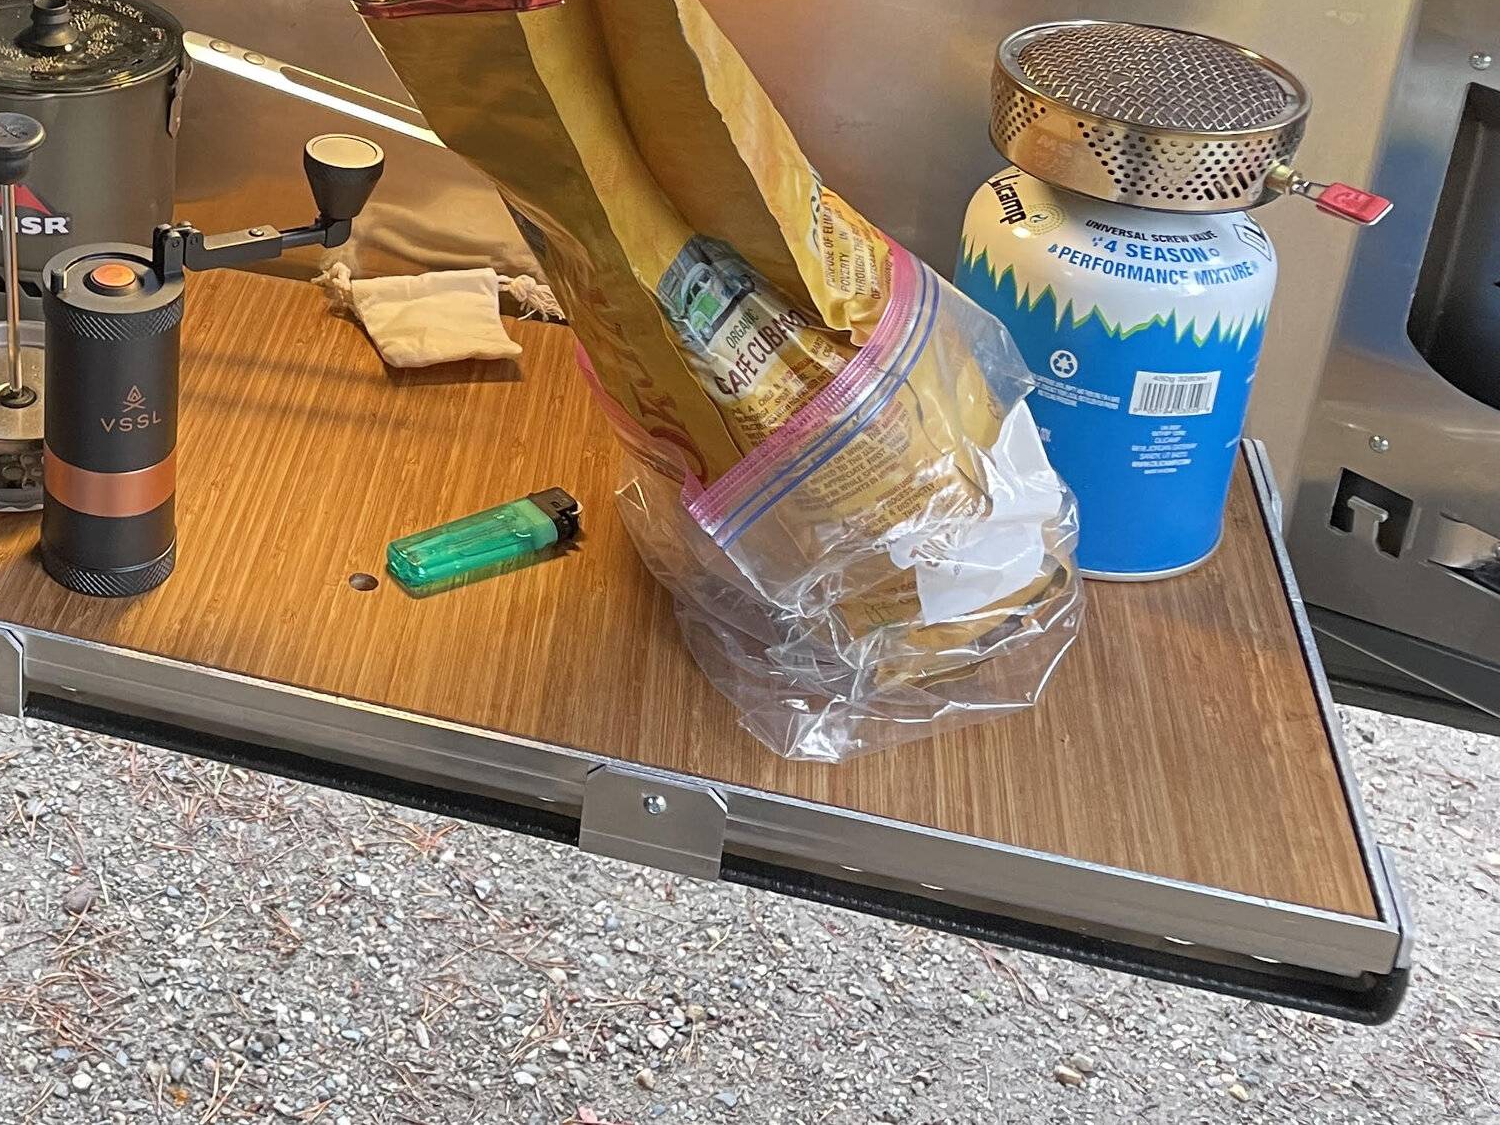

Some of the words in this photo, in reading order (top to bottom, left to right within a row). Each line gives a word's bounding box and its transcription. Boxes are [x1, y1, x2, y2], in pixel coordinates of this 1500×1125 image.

[1085, 219, 1148, 241] UNIVERSAL
[1151, 234, 1189, 243] SCREW
[1190, 230, 1218, 243] VALVE
[1058, 245, 1189, 285] PERFORMANCE
[1194, 261, 1255, 286] MIXTURE
[1104, 240, 1118, 253] 4
[1126, 243, 1209, 263] SEASON
[839, 253, 851, 293] POVERTY
[854, 254, 866, 296] THROUGH
[725, 308, 759, 350] ORGANIC
[100, 413, 162, 433] VSSL
